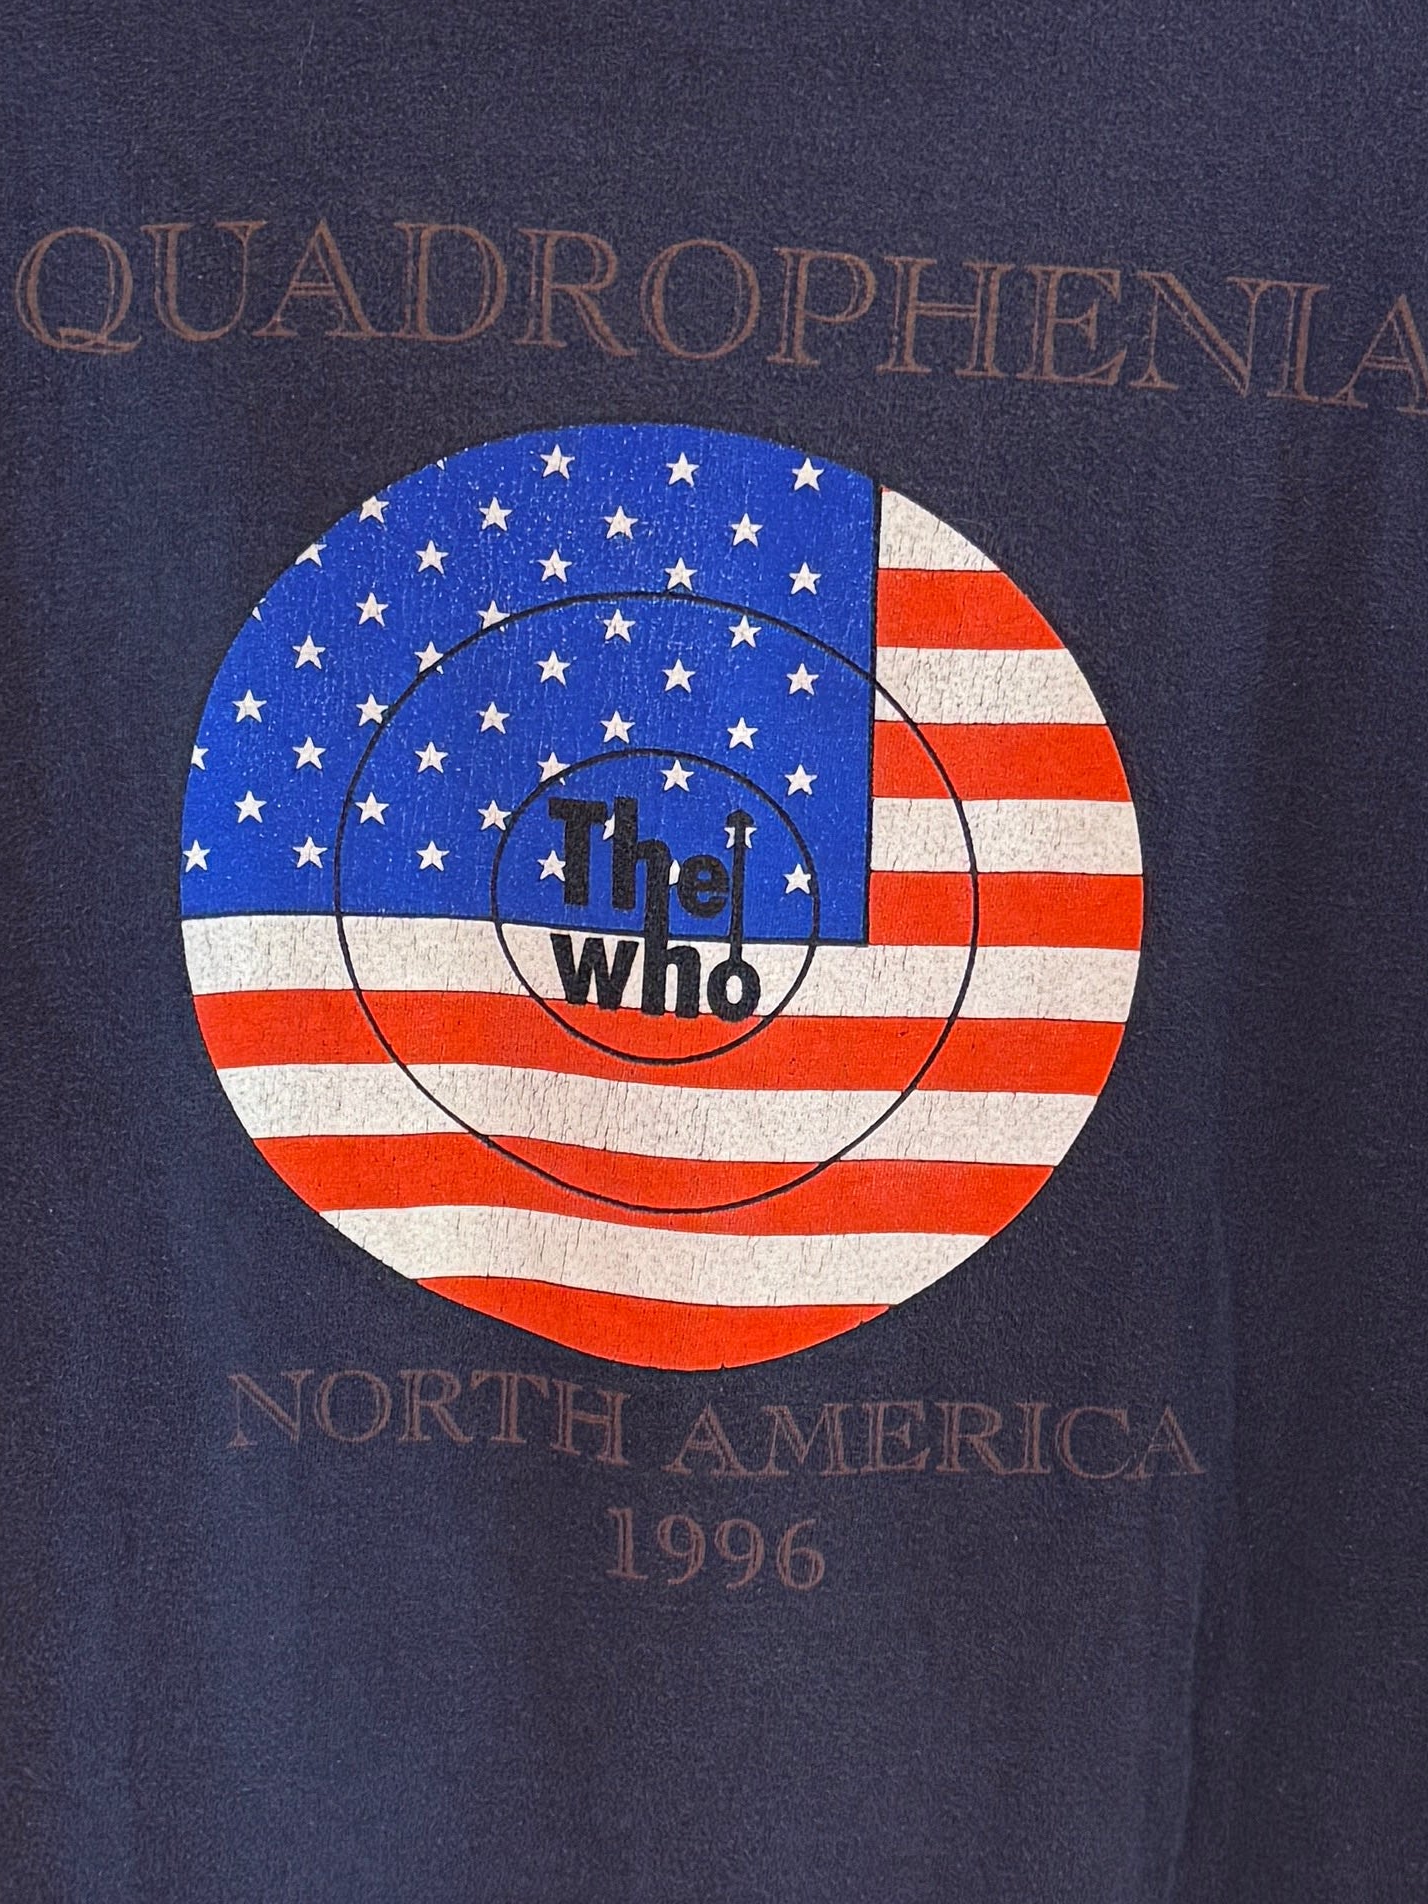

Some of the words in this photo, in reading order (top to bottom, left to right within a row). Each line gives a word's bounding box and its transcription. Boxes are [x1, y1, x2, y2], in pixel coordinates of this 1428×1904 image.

[548, 796, 730, 918] The
[226, 1368, 631, 1467] NORTH
[661, 1400, 1206, 1481] AMERICA
[607, 1506, 826, 1591] 1996
